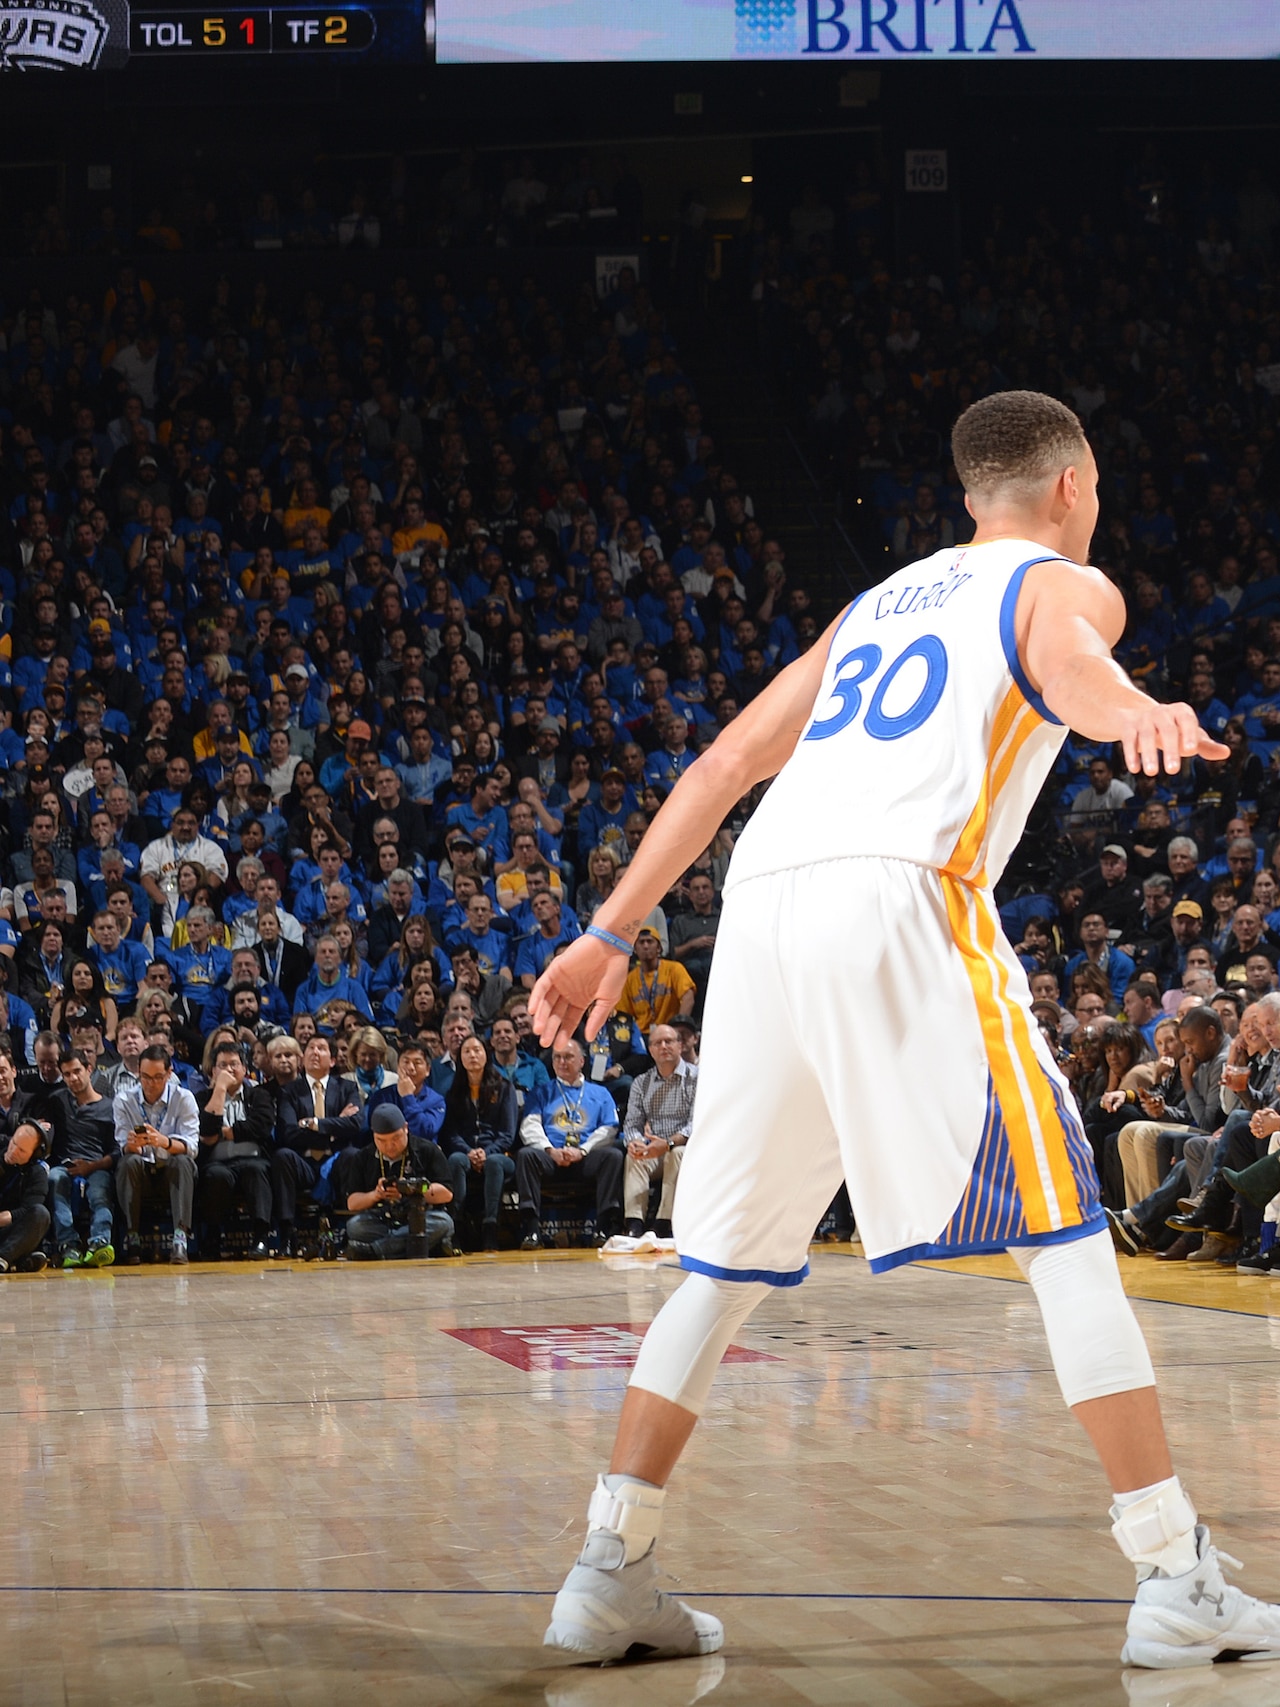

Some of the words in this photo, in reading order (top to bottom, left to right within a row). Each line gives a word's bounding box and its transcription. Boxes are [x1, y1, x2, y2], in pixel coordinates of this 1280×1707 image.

[140, 22, 193, 46] TOL
[203, 18, 227, 47] 5
[239, 18, 255, 46] 1
[287, 20, 320, 44] TF
[324, 16, 348, 45] 2
[801, 0, 1036, 53] BRITA
[913, 154, 940, 166] SEC
[908, 167, 945, 187] 109
[598, 273, 619, 294] 10
[875, 573, 973, 620] CURRY
[804, 634, 948, 742] 30
